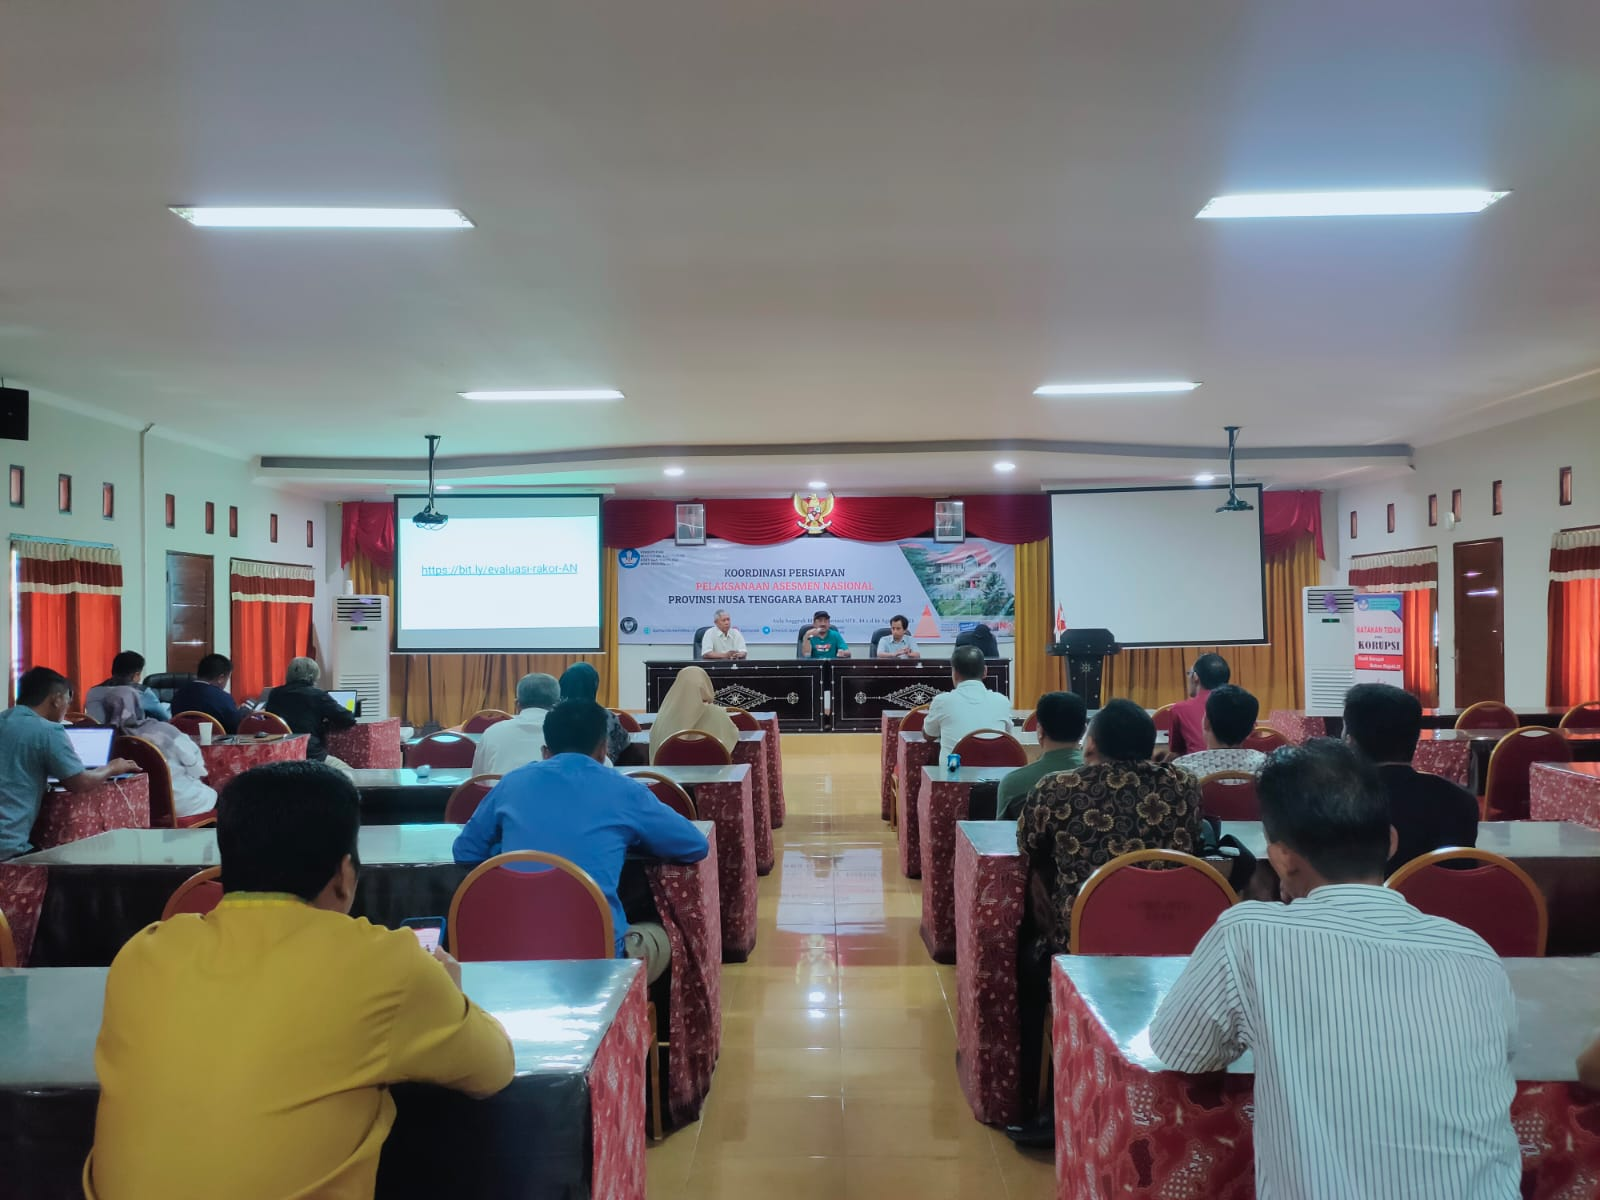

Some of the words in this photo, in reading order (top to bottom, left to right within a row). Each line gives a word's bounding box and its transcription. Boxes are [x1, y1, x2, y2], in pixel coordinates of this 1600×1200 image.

[724, 568, 786, 578] KOORDINASI
[789, 568, 845, 577] PERSIAPAN
[695, 582, 770, 591] PELAKSANAAN
[772, 582, 820, 590] ASESMEN
[823, 581, 874, 590] NASIONAL
[668, 595, 716, 604] PROVINSI
[718, 595, 745, 604] NUSA
[748, 595, 802, 604] TENGGARA
[805, 595, 837, 604] BARAT
[840, 595, 877, 604] TAHUN
[878, 595, 902, 604] 2023
[1358, 641, 1400, 651] KORUPSI
